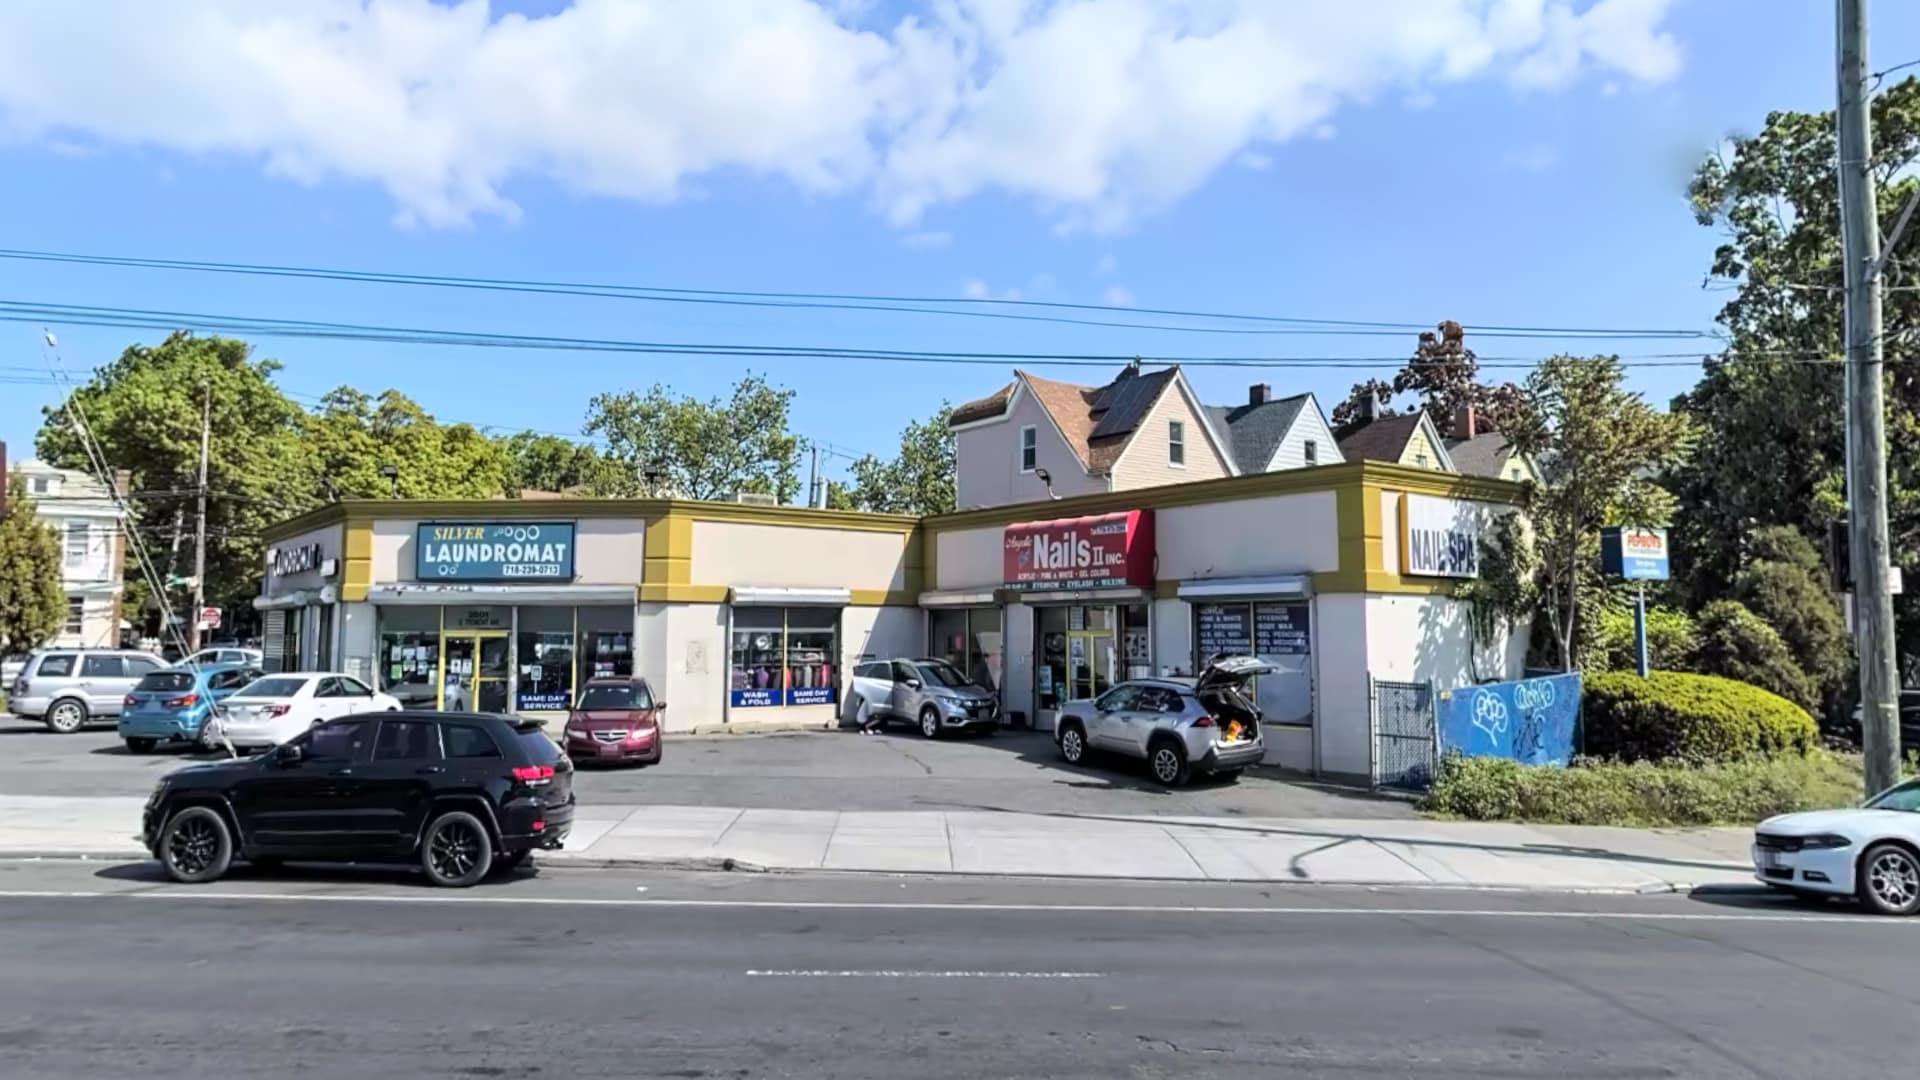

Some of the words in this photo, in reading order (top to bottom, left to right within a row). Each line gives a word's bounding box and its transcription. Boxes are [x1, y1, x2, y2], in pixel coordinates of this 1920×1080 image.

[434, 527, 485, 541] SILVER
[425, 543, 566, 563] LAUNDROMAT
[1033, 531, 1091, 569] Nails
[1092, 546, 1104, 565] II
[1105, 553, 1125, 565] INC.
[1449, 531, 1475, 573] SPA
[1059, 571, 1074, 579] WHITE
[1066, 580, 1094, 588] EYELASH
